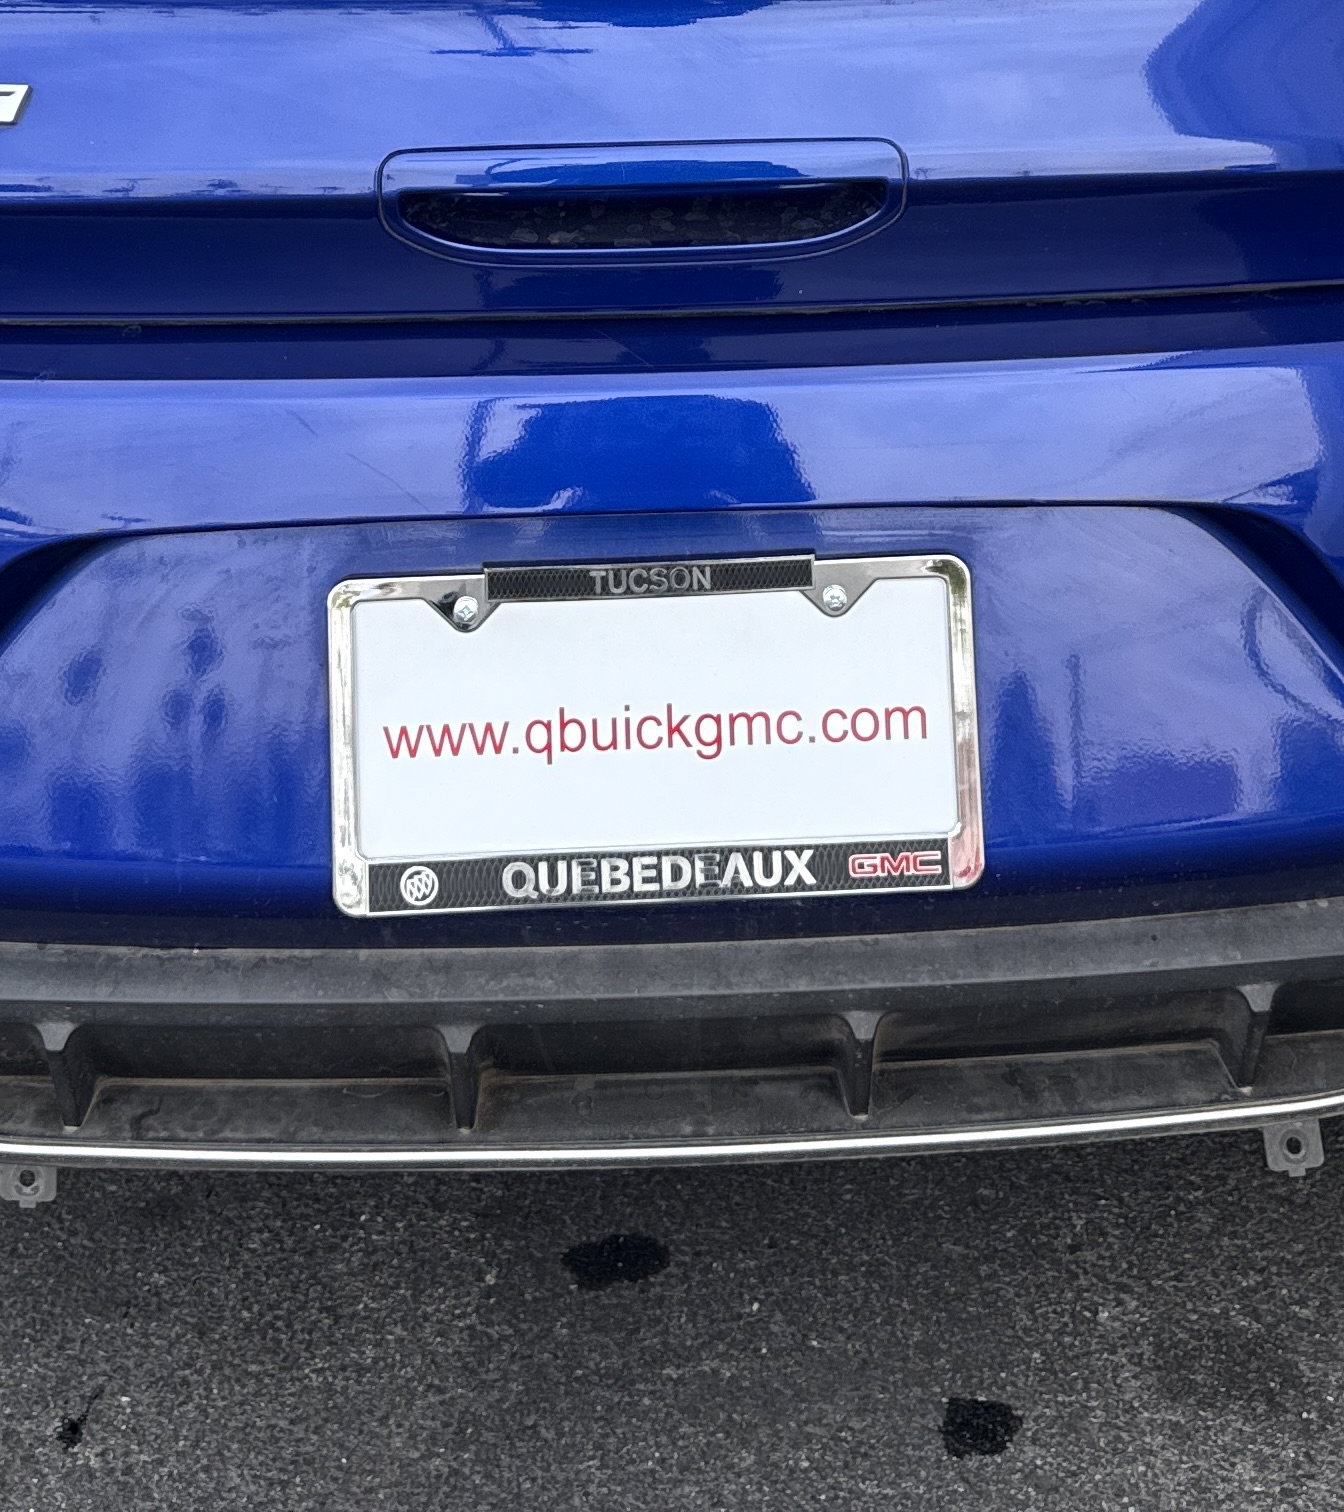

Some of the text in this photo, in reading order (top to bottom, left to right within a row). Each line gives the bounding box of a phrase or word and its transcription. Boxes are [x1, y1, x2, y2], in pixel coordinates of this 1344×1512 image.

[589, 565, 712, 594] TUCSON
[382, 702, 928, 764] www.qbuickgmc.com
[501, 849, 943, 900] QUEBEDEAUX GMC
